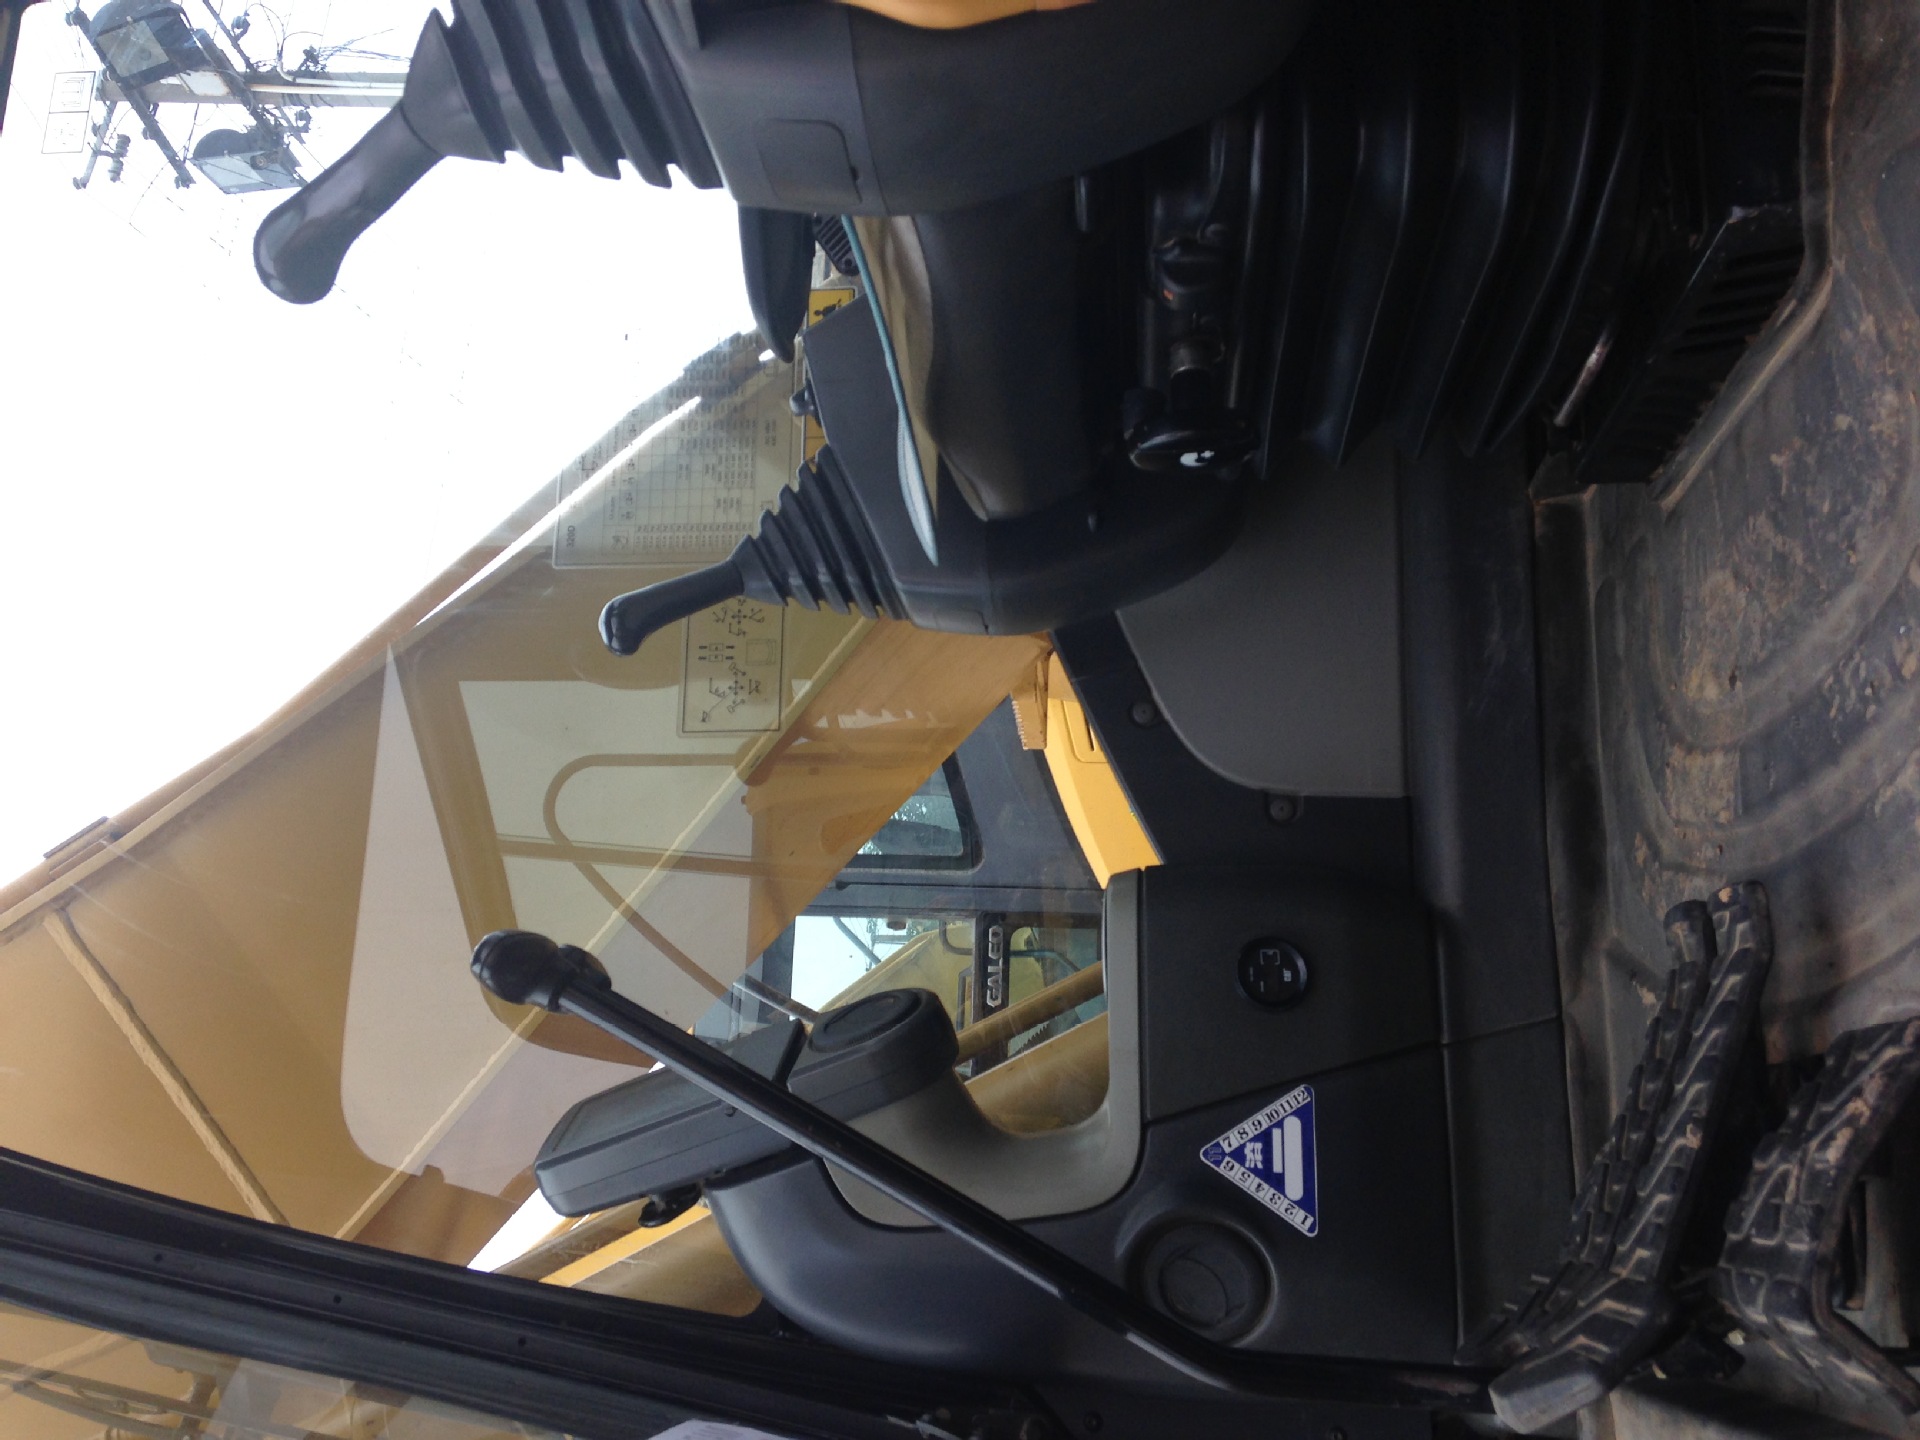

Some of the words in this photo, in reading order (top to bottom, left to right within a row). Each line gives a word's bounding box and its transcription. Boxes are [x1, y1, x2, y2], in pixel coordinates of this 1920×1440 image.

[566, 525, 576, 548] 320D
[986, 925, 1003, 1008] GALEO
[1223, 1136, 1232, 1147] 7
[1237, 1128, 1248, 1139] 8
[1252, 1119, 1262, 1131] 9
[1265, 1110, 1279, 1123] 10
[1281, 1100, 1293, 1114] 11
[1292, 1091, 1309, 1104] 12
[1244, 1142, 1263, 1168] 済
[1224, 1161, 1235, 1172] 6
[1240, 1172, 1251, 1182] 5
[1255, 1183, 1265, 1193] 4
[1270, 1193, 1281, 1205] 3
[1284, 1203, 1296, 1215] 2
[1301, 1214, 1309, 1226] 1
